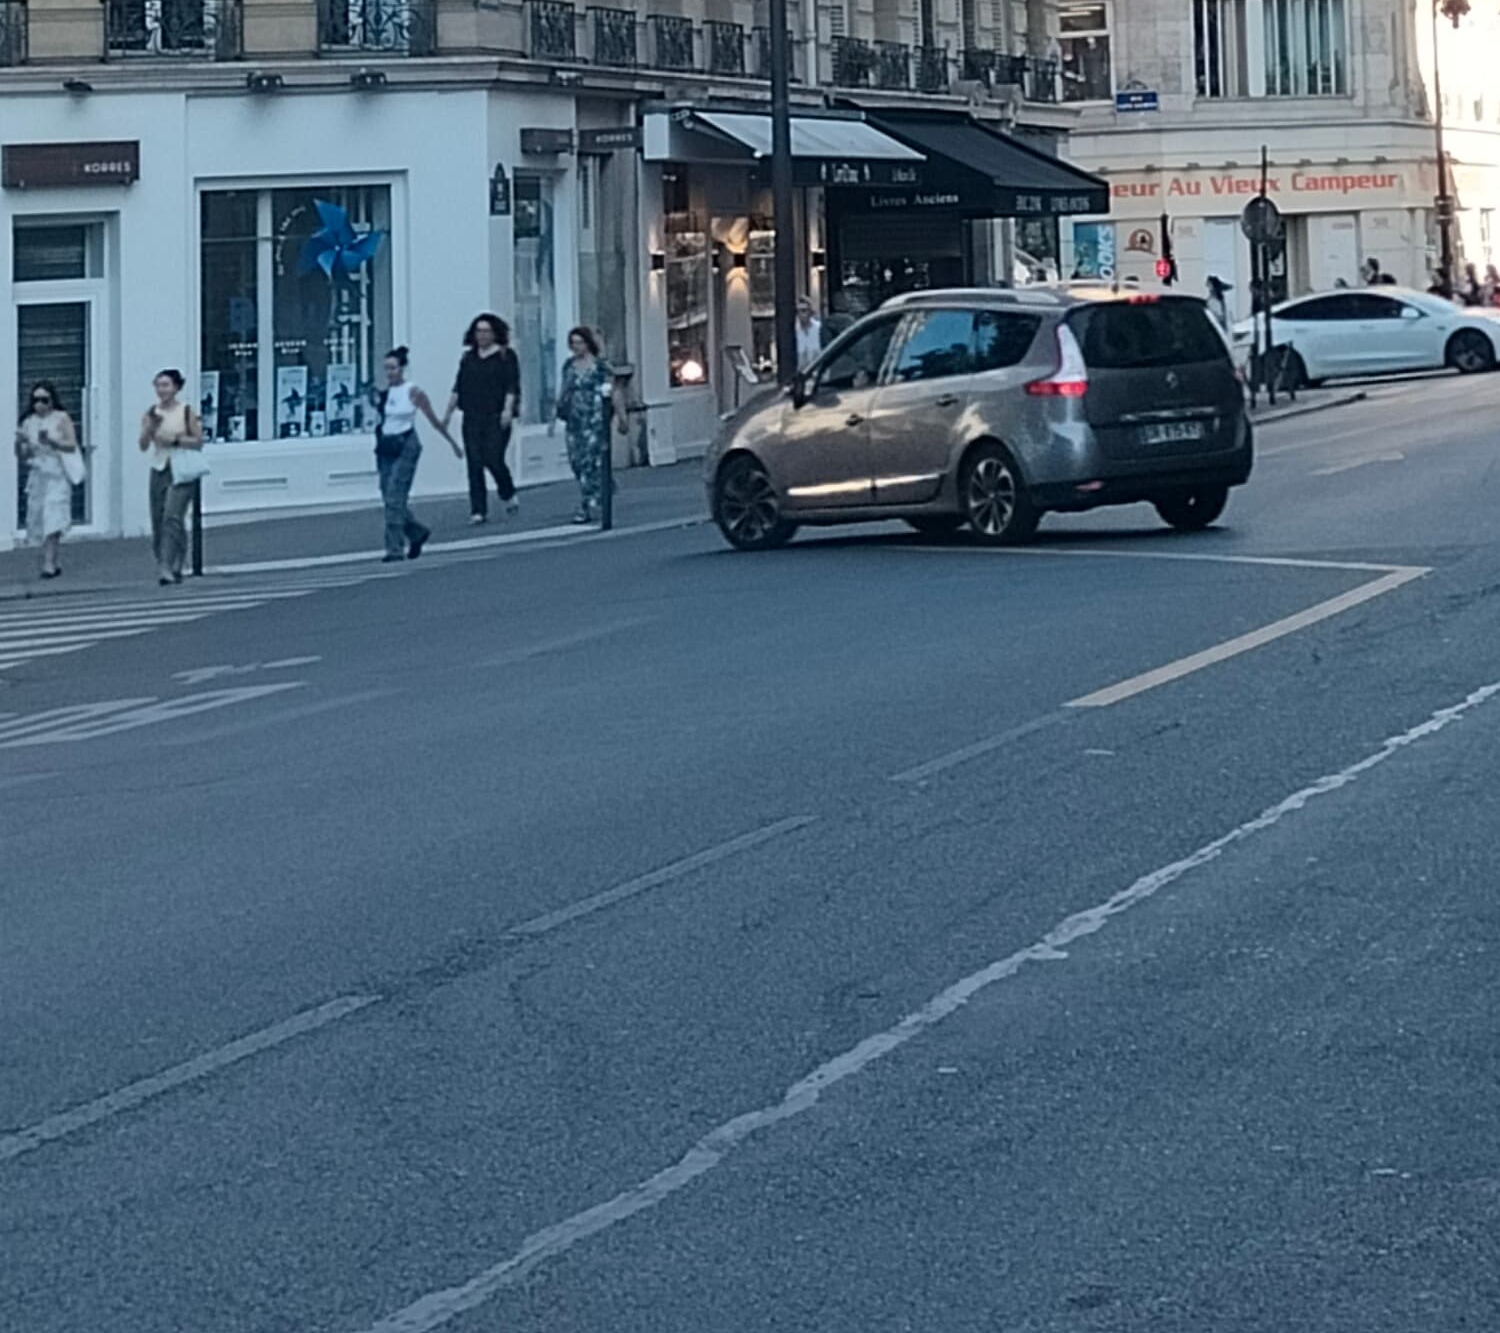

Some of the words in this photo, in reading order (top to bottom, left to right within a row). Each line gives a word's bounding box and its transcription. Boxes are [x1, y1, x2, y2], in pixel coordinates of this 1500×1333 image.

[84, 161, 131, 173] KORRES
[1111, 182, 1161, 197] eur
[1167, 177, 1201, 196] Au
[1209, 174, 1281, 195] Vieux
[1291, 172, 1398, 194] Campeur
[914, 193, 959, 205] Anciens
[1097, 224, 1114, 281] OOKS
